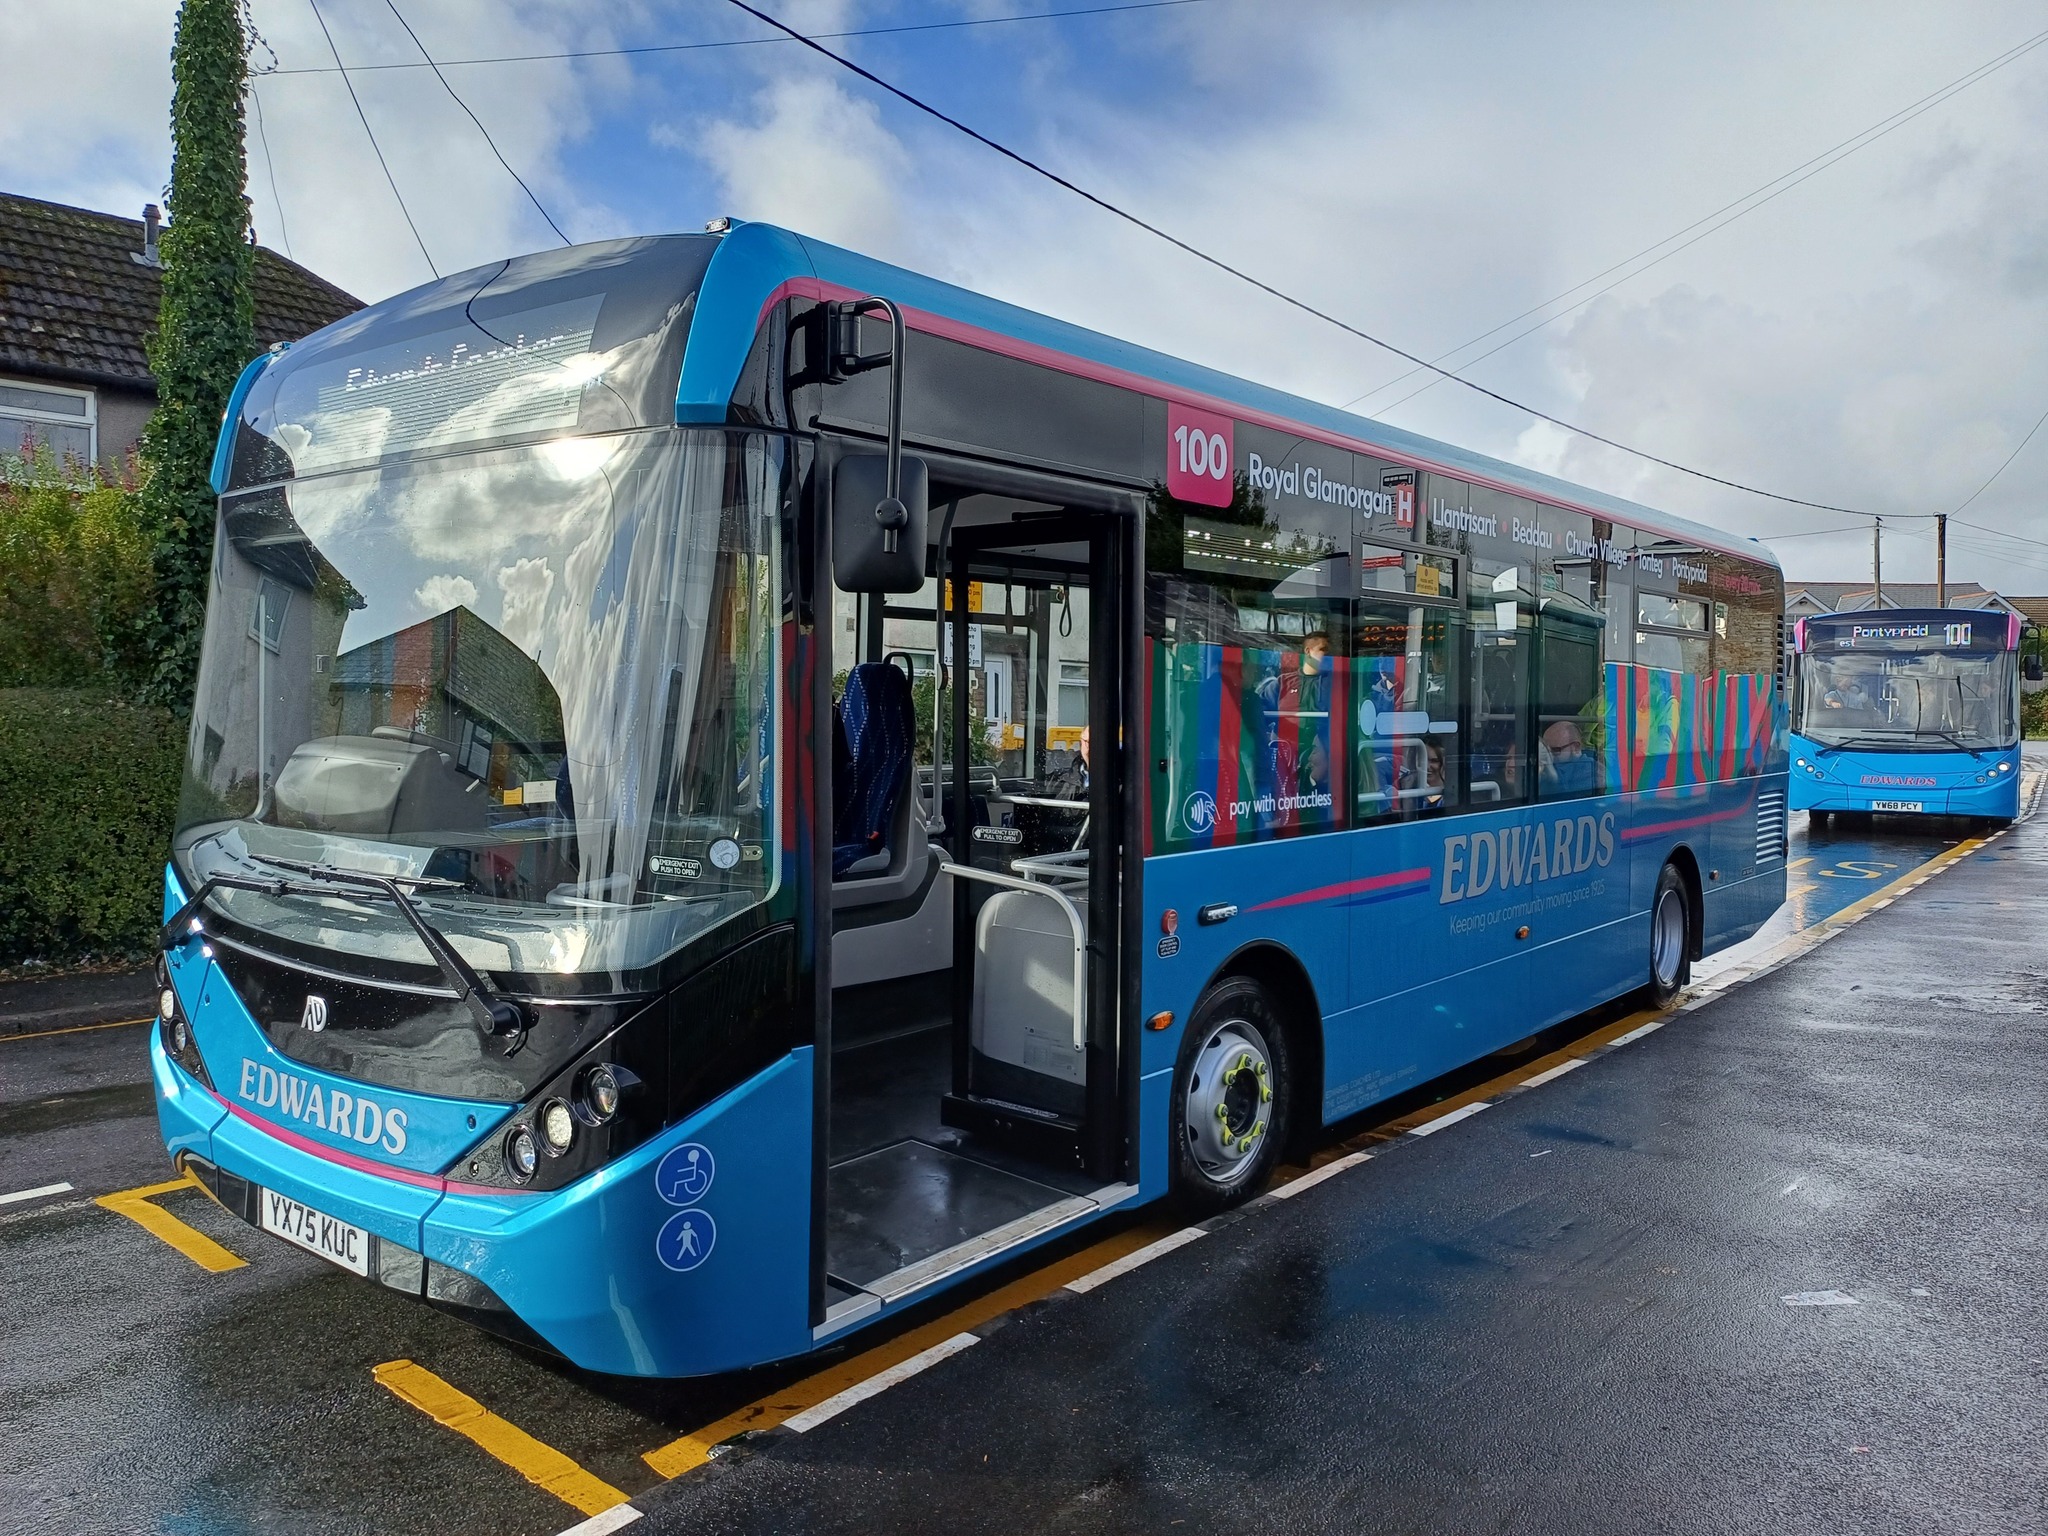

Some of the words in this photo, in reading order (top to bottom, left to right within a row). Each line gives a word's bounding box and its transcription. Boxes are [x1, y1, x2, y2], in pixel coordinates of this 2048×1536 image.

[1174, 425, 1228, 480] 100
[1249, 453, 1300, 500] Royal
[1303, 467, 1393, 519] Glamorgan
[1398, 490, 1412, 523] H
[1433, 498, 1497, 538] Llantrisant
[1513, 517, 1552, 550] Beddau
[1565, 530, 1598, 560] Church
[1599, 536, 1627, 570] Village
[1638, 549, 1663, 579] Tonteg
[1672, 557, 1708, 586] Pontypridd
[1853, 625, 1929, 639] Pontypridd
[1943, 623, 1972, 646] 100
[1860, 774, 1937, 787] EDWARDS
[1230, 800, 1251, 820] pay
[1253, 793, 1276, 813] with
[1278, 789, 1332, 810] contactless
[1875, 801, 1899, 810] YW68
[1900, 802, 1918, 811] PCY
[980, 828, 1008, 836] EMERGENCY
[660, 859, 687, 869] EMERGENCY
[688, 862, 699, 870] EXIT
[1439, 811, 1616, 905] EDWARDS
[1450, 914, 1486, 936] Keeping
[1487, 910, 1501, 926] our
[1503, 896, 1546, 921] community
[1546, 893, 1572, 909] moving
[1573, 886, 1590, 901] since
[239, 1057, 409, 1156] EDWARDS
[270, 1192, 317, 1244] YX75
[321, 1212, 358, 1264] KUC
